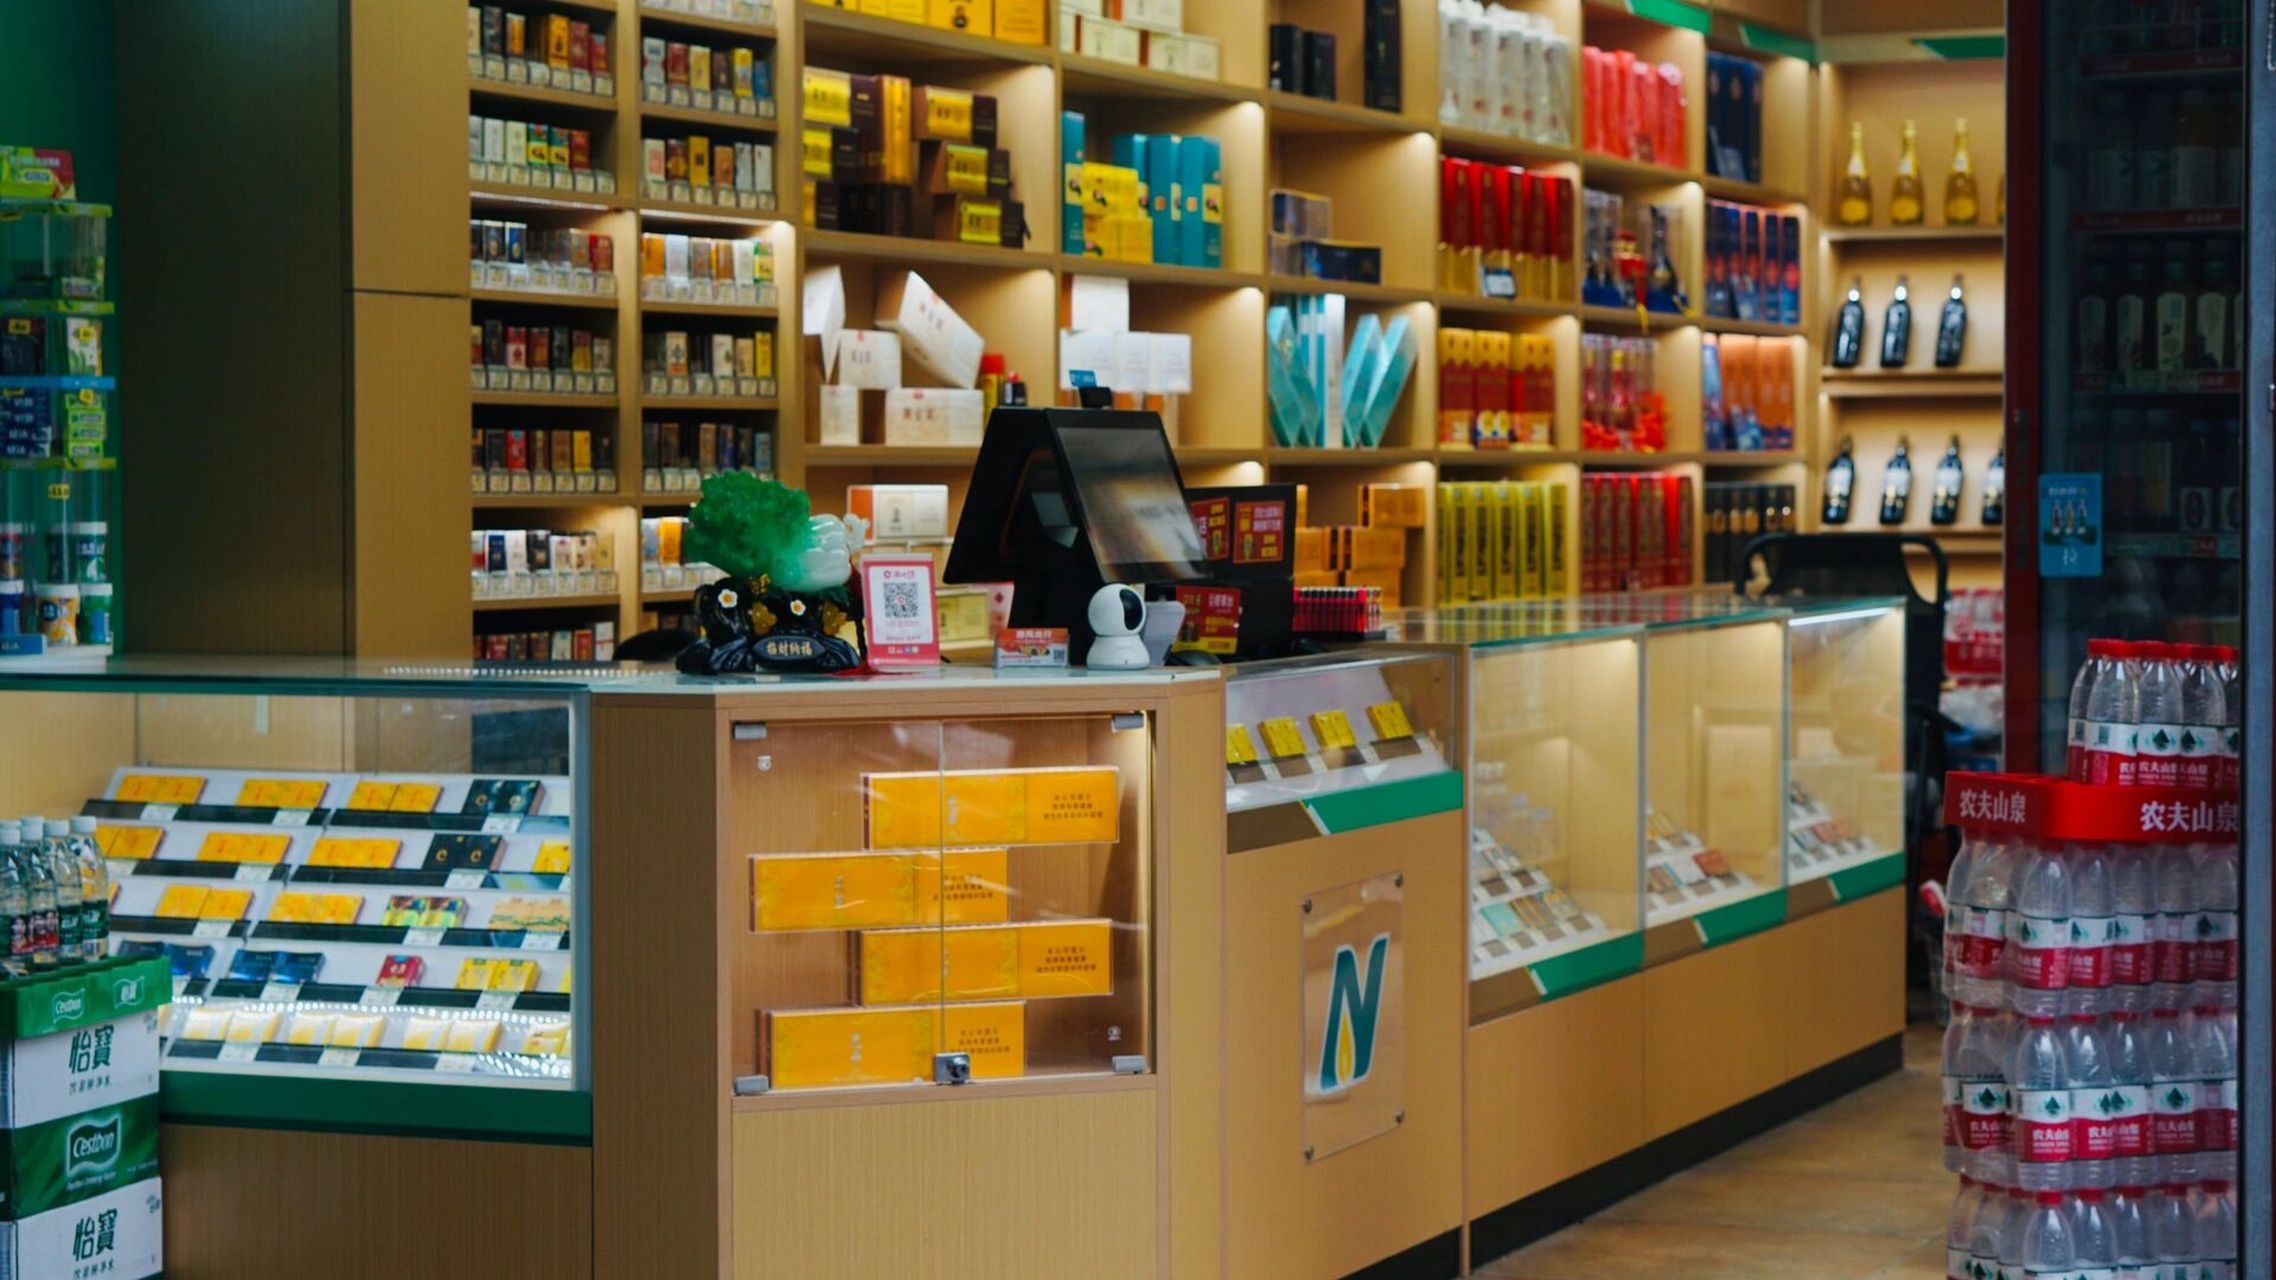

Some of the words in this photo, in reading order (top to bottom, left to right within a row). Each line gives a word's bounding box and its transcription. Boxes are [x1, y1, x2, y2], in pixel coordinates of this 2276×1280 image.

[1959, 789, 2026, 824] 农夫山泉
[2141, 800, 2239, 833] 农夫山泉
